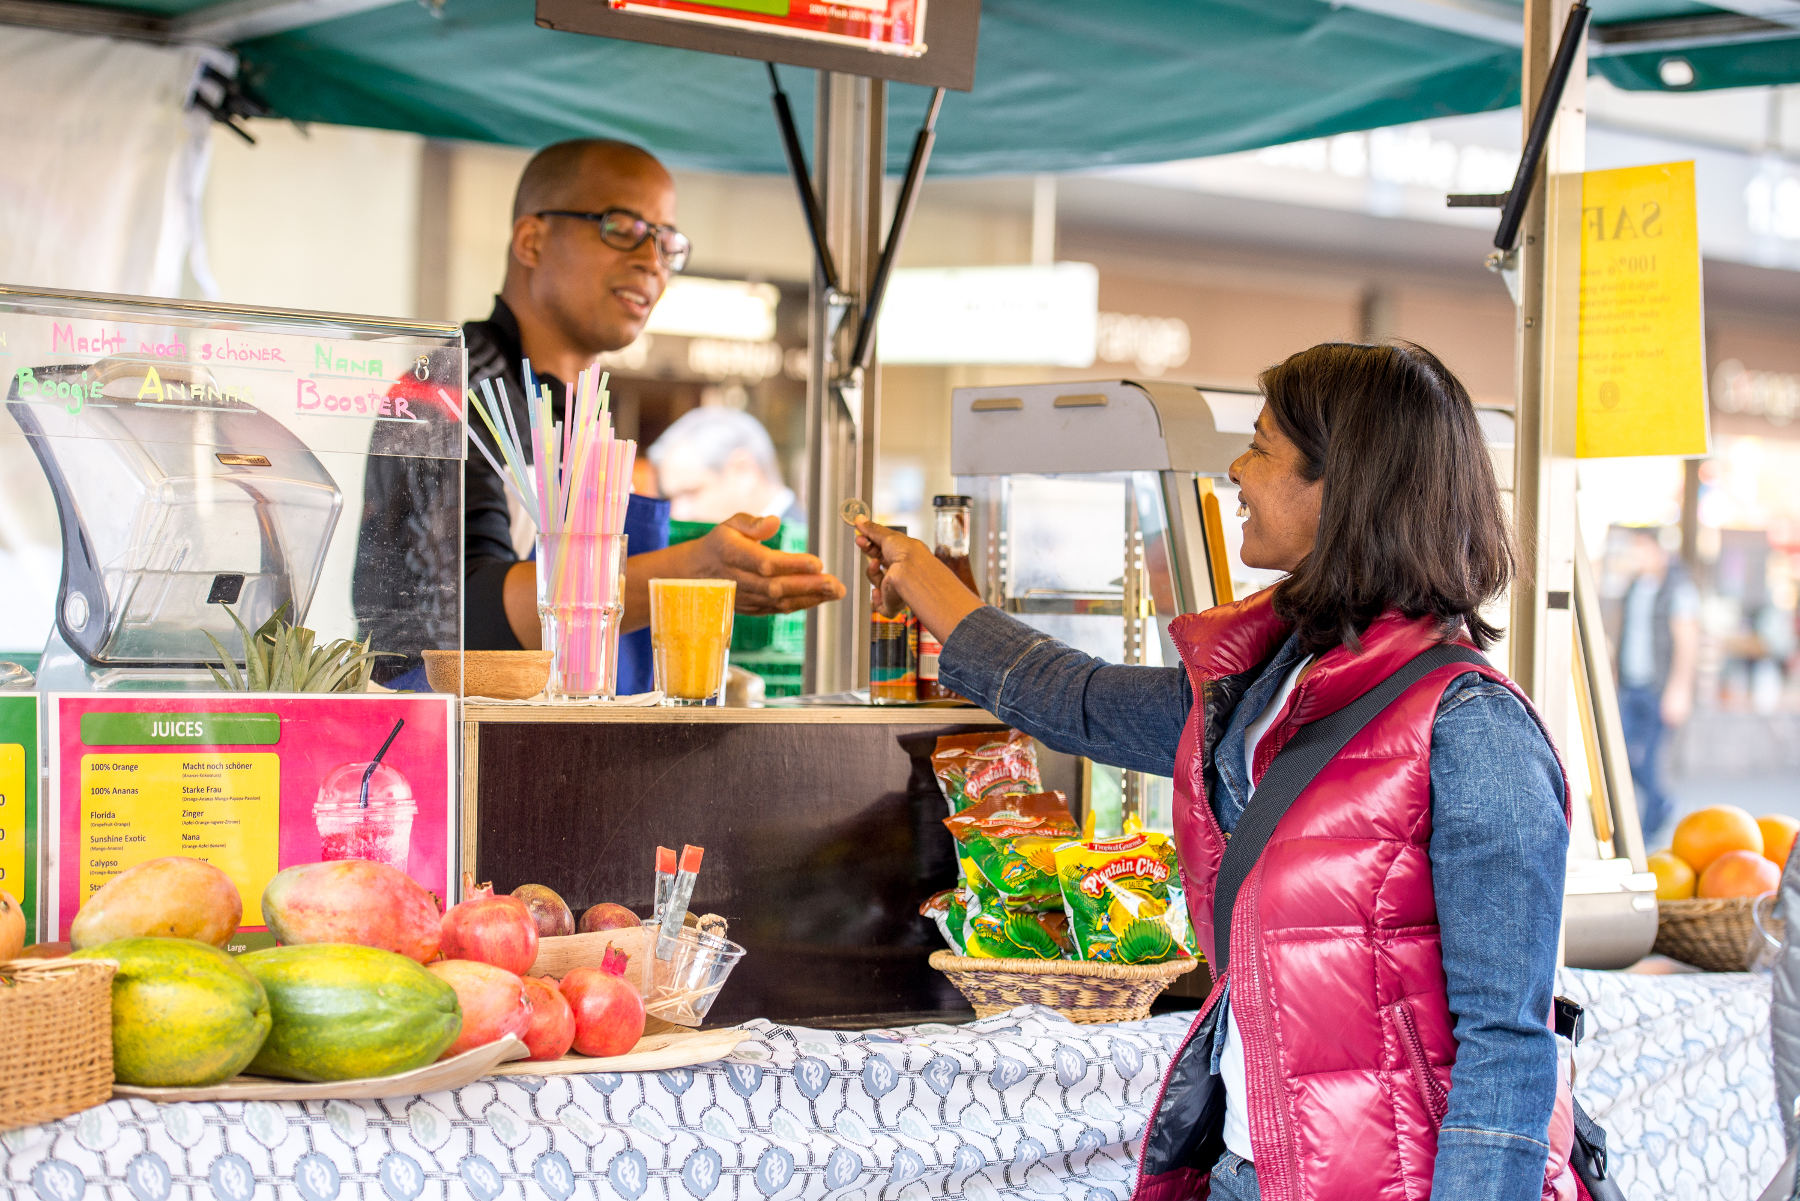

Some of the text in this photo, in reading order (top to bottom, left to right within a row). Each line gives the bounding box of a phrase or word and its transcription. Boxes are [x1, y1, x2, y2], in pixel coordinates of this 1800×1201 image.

[151, 720, 204, 737] JUICES
[91, 763, 139, 773] 100% Orange
[182, 762, 253, 770] Macht noch schöner
[91, 787, 139, 795] 100% Ananas
[182, 786, 222, 794] Starke Frau
[90, 811, 116, 819] Florida
[182, 809, 204, 819] Zinger
[90, 834, 146, 843] Sunshine Exotic
[181, 833, 200, 841] Nana
[90, 859, 118, 869] Calypso
[1083, 857, 1168, 895] Plantain Chips
[227, 944, 247, 953] Large
